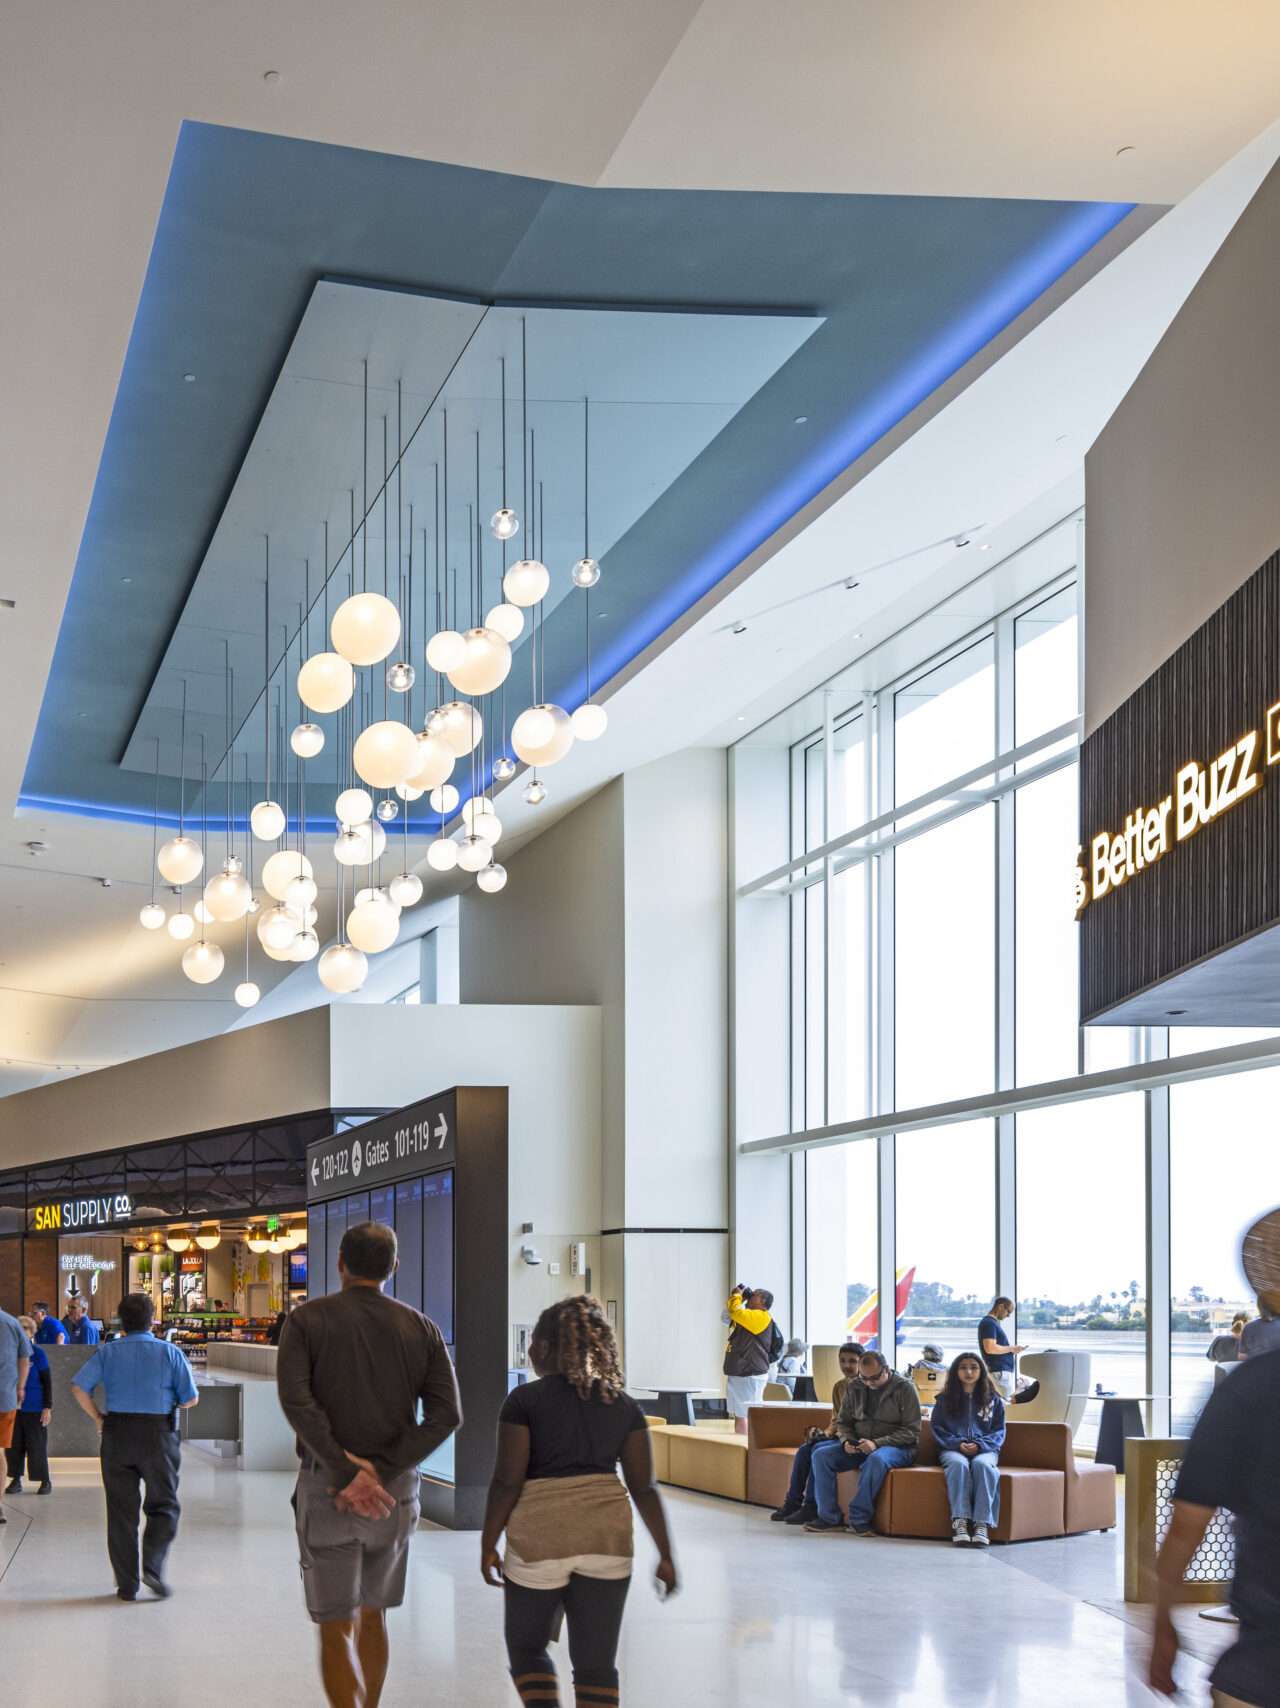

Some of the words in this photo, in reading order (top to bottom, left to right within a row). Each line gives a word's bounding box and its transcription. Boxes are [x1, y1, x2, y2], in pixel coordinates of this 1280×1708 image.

[1092, 795, 1172, 900] Better
[1177, 730, 1258, 842] Buzz
[322, 1149, 349, 1180] 120-122
[365, 1140, 390, 1167] Gates
[395, 1121, 429, 1158] 101-119
[35, 1204, 61, 1231] SAN
[63, 1198, 112, 1227] SUPPLY
[114, 1195, 131, 1213] CO.
[62, 1255, 75, 1263] PAY
[76, 1255, 94, 1263] HERE
[62, 1262, 79, 1270] SELF
[79, 1261, 116, 1270] CHECKOUT
[182, 1257, 189, 1265] LA
[189, 1257, 203, 1265] JOLLA
